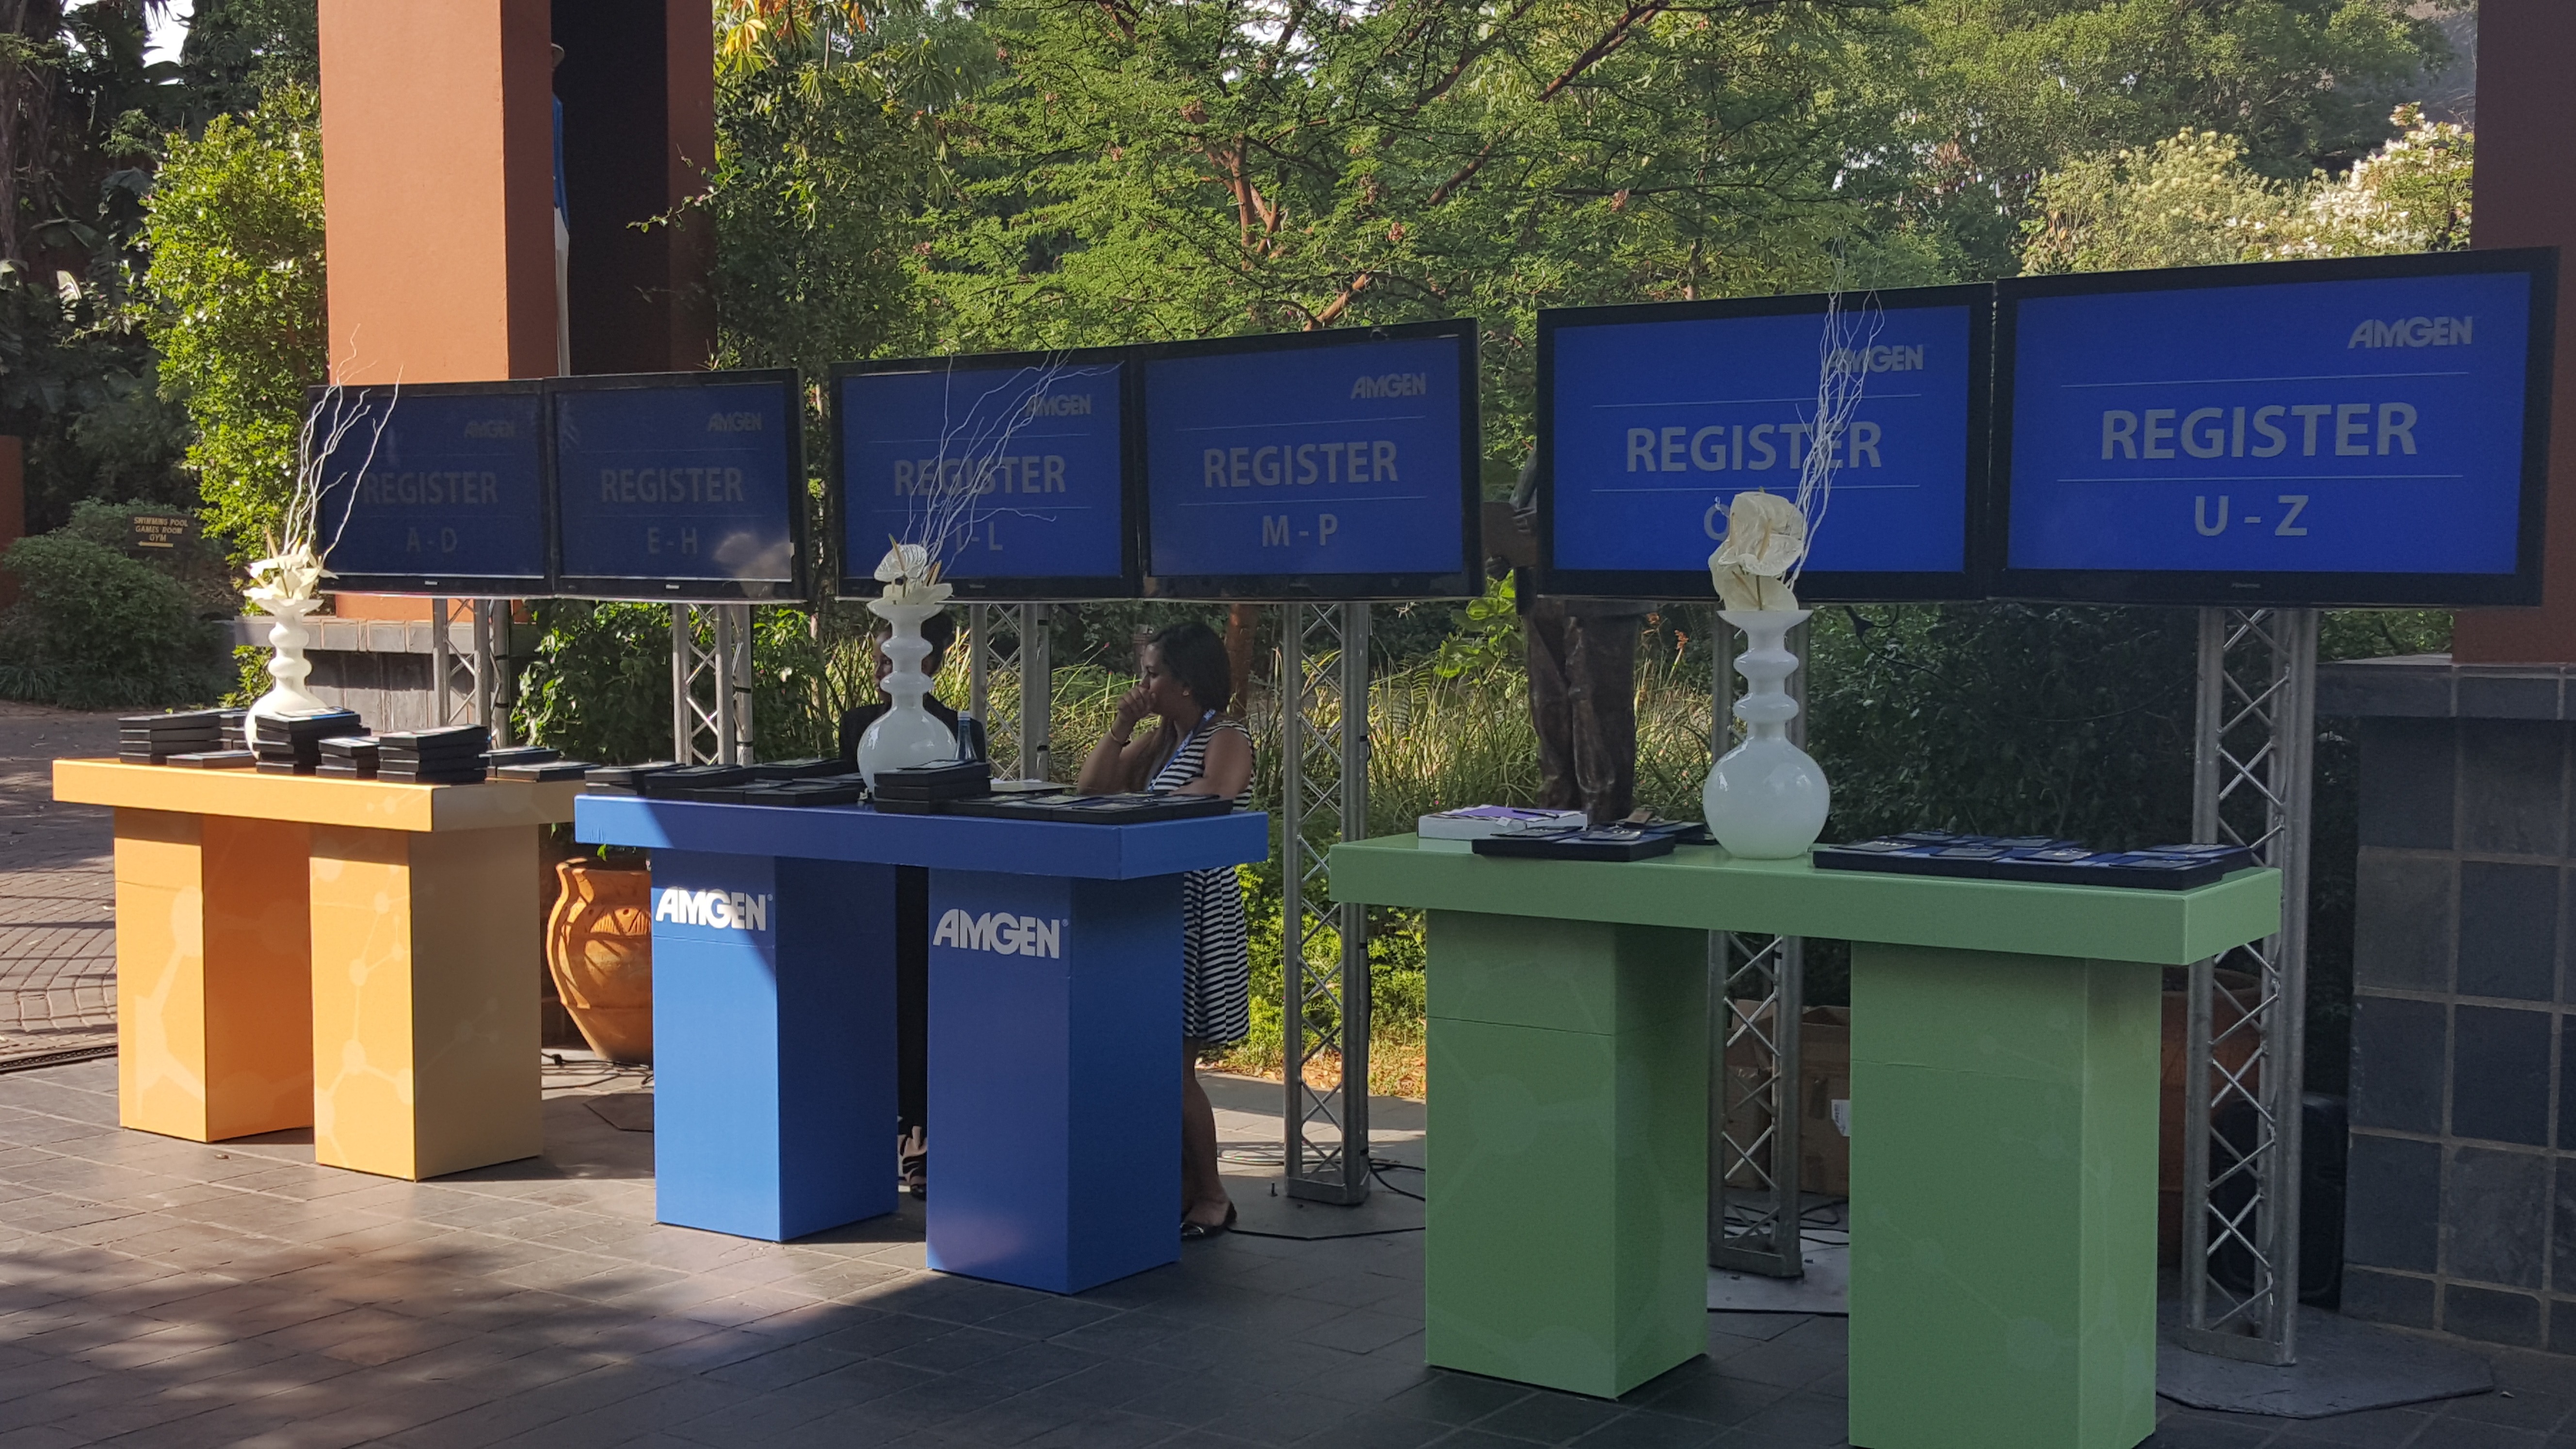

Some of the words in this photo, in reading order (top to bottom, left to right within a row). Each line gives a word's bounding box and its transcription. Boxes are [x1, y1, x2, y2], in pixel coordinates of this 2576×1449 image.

[2348, 316, 2472, 349] AMGEN
[1826, 345, 1923, 373] AMGEN
[1351, 372, 1426, 399] AMGEN
[708, 412, 762, 432] AMGEN
[1025, 394, 1091, 417] AMGEN
[1627, 421, 1882, 472] REGISTER
[2101, 402, 2417, 459] REGISTER
[895, 455, 1066, 496] REGISTER
[1204, 441, 1398, 487] REGISTER
[364, 471, 498, 504] REGISTER
[601, 467, 744, 502] REGISTER
[133, 516, 168, 525] SWIMMING
[170, 518, 188, 527] POOL
[135, 525, 160, 533] GAMES
[656, 886, 766, 931] AMGEN
[933, 908, 1060, 959] AMGEN
